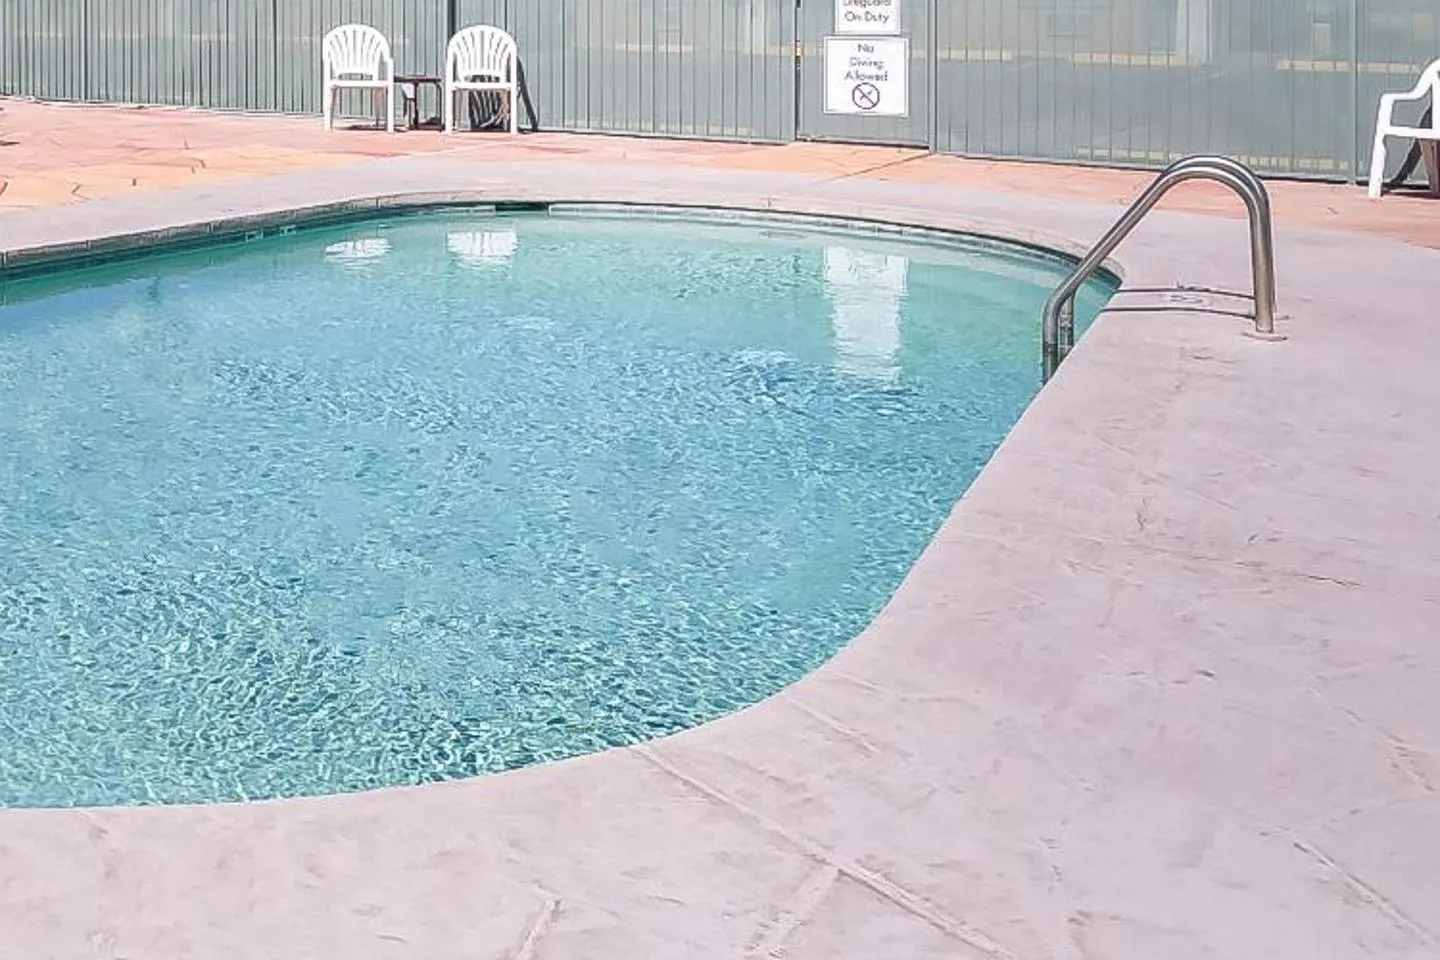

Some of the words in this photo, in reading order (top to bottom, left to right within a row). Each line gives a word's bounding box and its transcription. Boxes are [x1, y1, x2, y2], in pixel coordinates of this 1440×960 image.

[844, 11, 861, 22] On
[865, 11, 890, 24] Duty
[858, 43, 875, 53] No
[849, 57, 885, 70] Diving
[844, 71, 888, 81] Allowed
